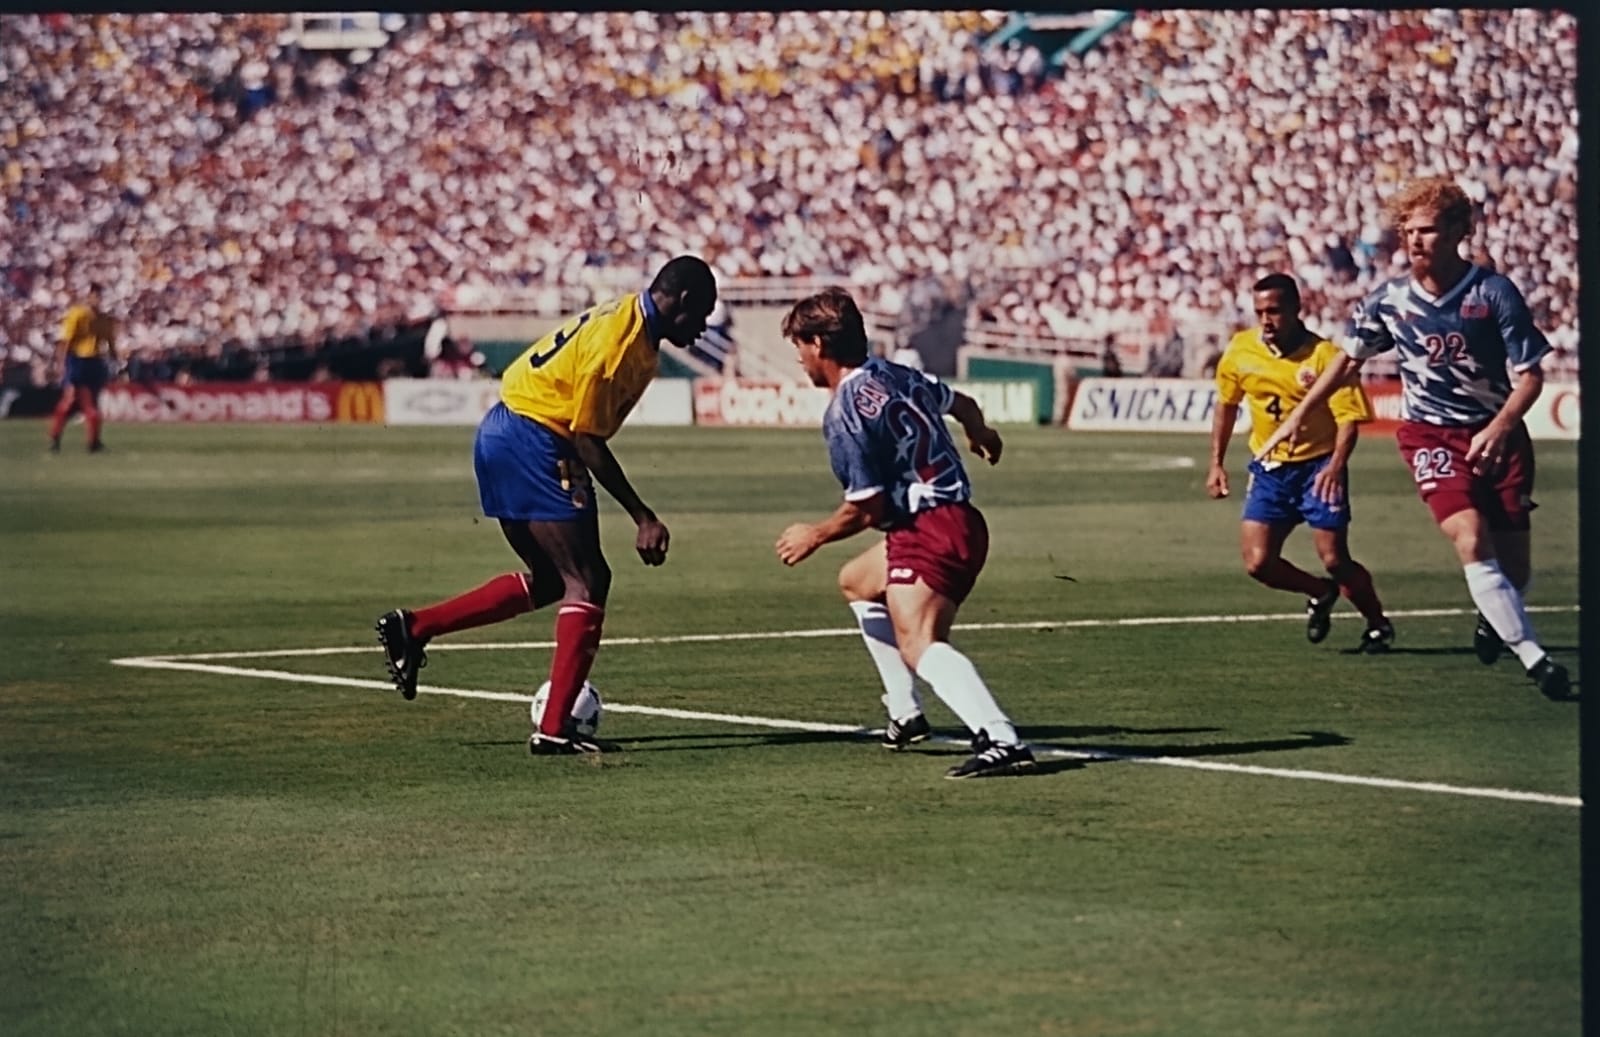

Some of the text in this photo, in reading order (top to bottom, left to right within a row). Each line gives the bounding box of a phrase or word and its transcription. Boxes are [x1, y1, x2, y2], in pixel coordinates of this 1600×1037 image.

[1425, 331, 1472, 368] 22
[1082, 387, 1243, 421] SNICKER
[1265, 395, 1283, 421] 4
[1413, 448, 1456, 482] 22
